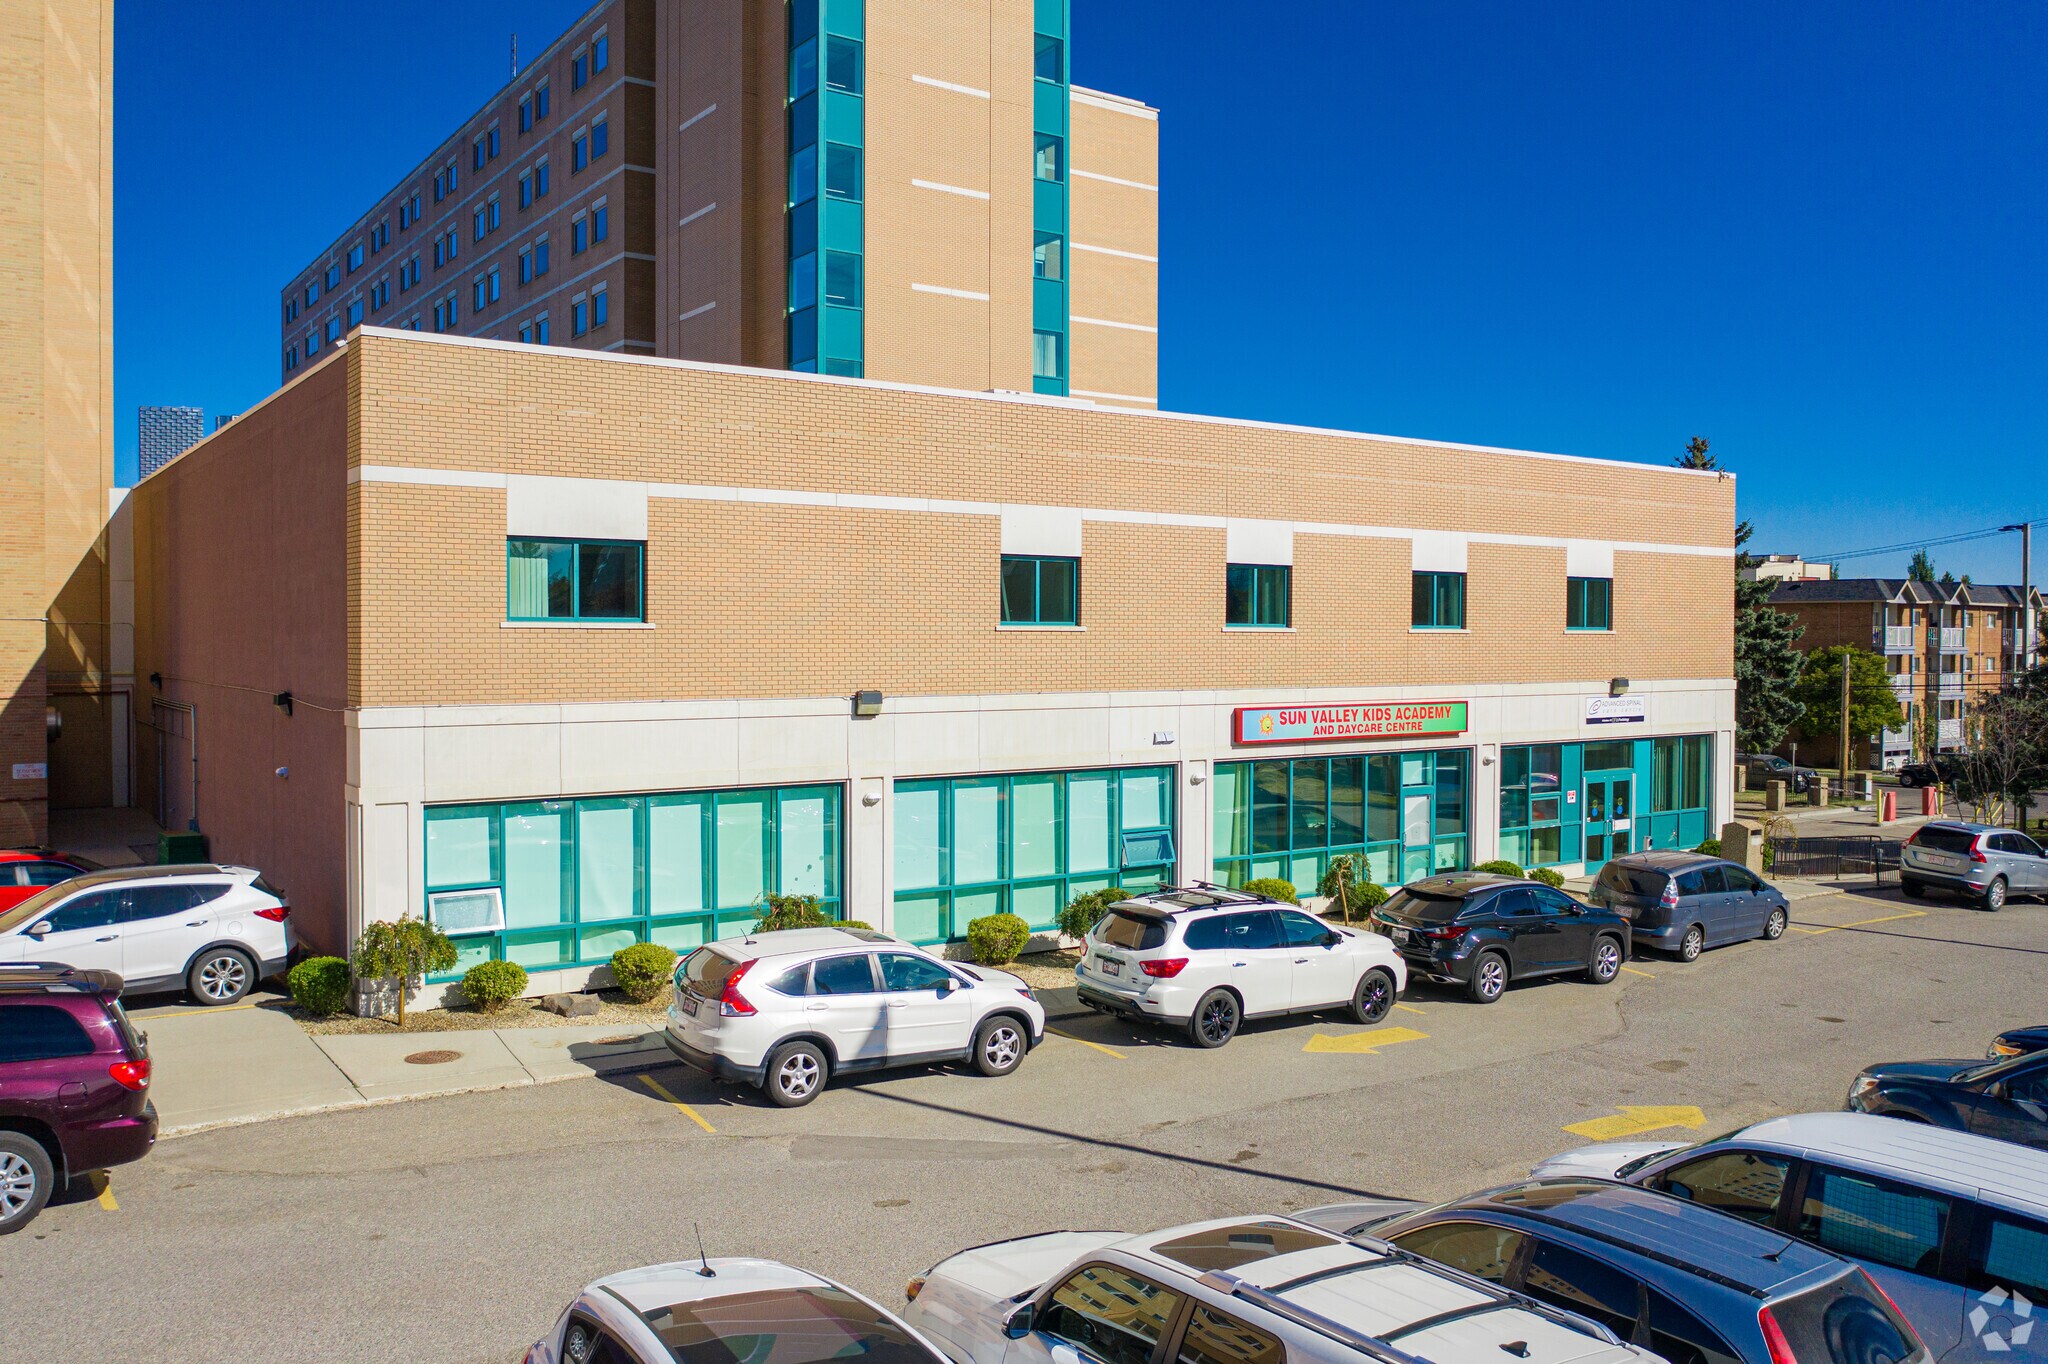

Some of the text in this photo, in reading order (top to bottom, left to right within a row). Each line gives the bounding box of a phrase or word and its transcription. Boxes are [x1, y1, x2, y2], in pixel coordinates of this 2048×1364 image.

[1279, 706, 1452, 725] SUN VALLEY KIDS ACADEMY
[1313, 721, 1423, 735] AND DAYCARE CENTRE
